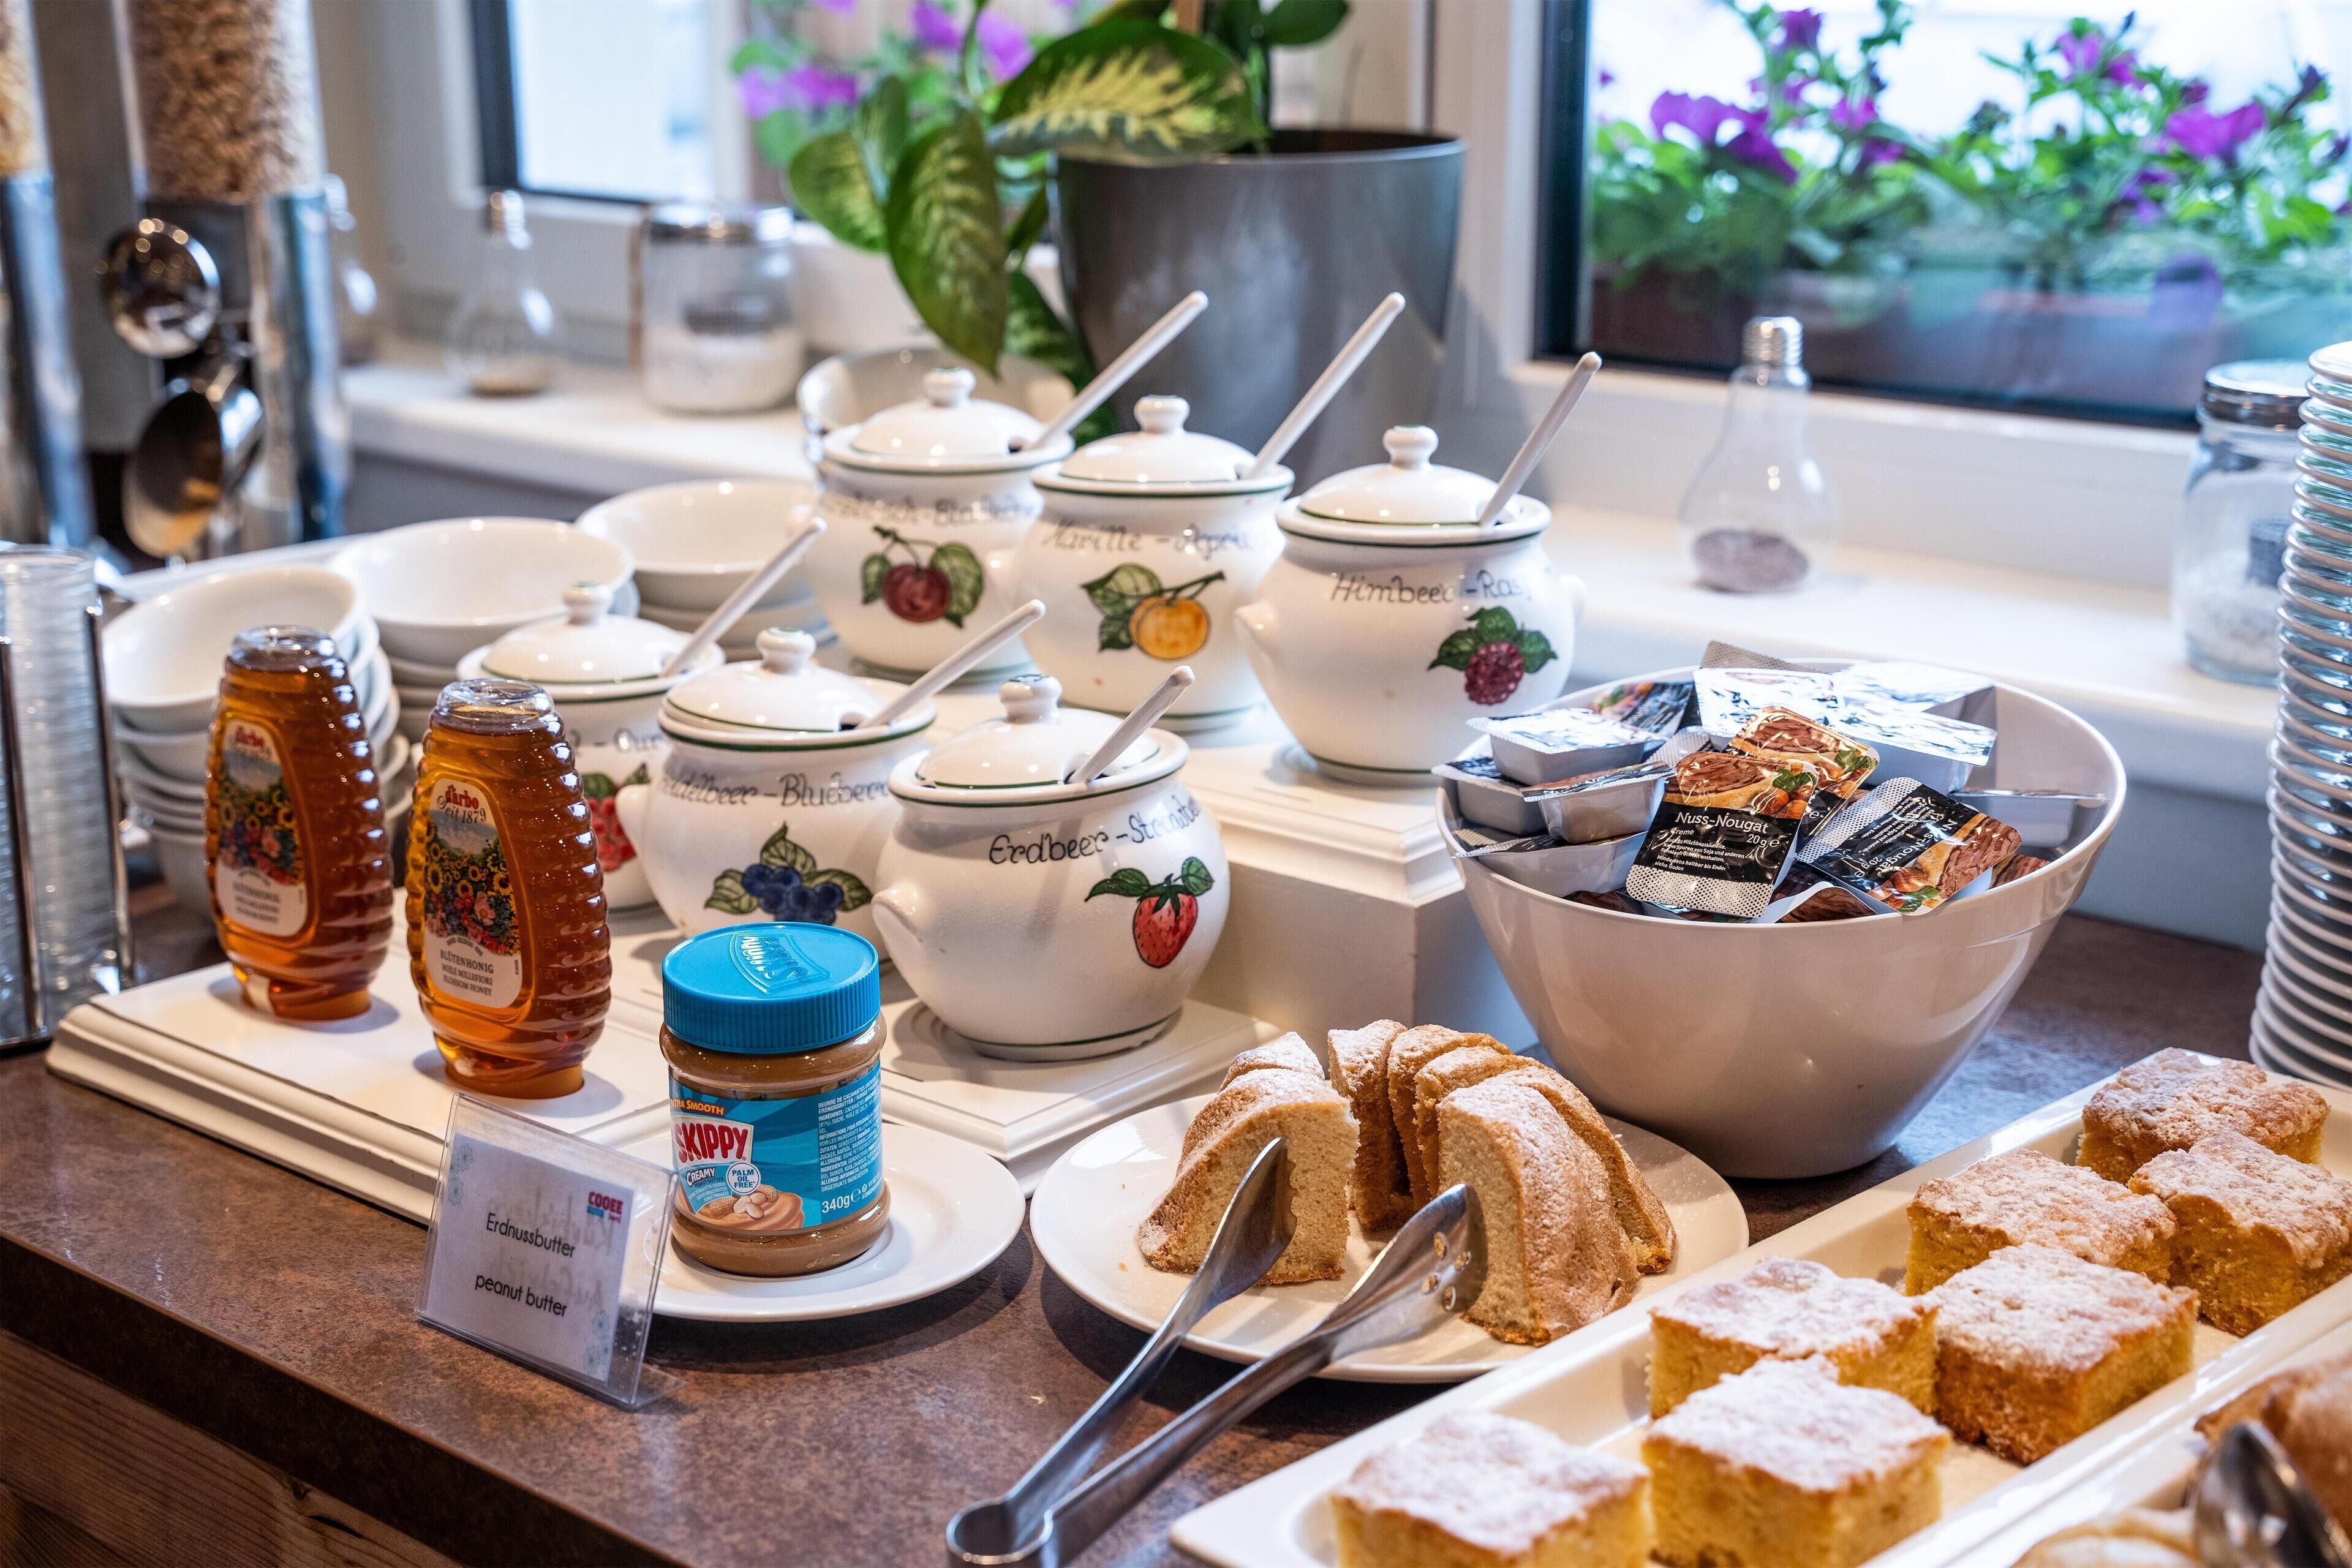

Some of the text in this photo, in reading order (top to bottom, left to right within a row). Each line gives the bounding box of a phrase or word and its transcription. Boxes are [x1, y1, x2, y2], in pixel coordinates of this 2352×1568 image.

[462, 808, 486, 824] 1879
[1675, 811, 1769, 834] Nuss-Nougat
[1657, 855, 1685, 865] Mindestens
[440, 949, 494, 974] BLÜTENHONIG
[458, 970, 492, 986] MILLEFIORI
[470, 983, 492, 996] HONEY
[686, 1100, 725, 1115] SMOOTH
[818, 1098, 836, 1109] BEURRE
[818, 1098, 853, 1114] ERDNUSSBUTTER
[819, 1127, 846, 1140] INFORMATIONS
[674, 1122, 748, 1163] SKIPPY
[820, 1144, 837, 1154] ZUTATEN:
[820, 1156, 842, 1166] ALLERGENE:
[687, 1167, 715, 1186] CREAMY
[588, 1191, 624, 1214] COOEE
[821, 1195, 850, 1213] 340g
[486, 1212, 576, 1258] Erdnussbutter
[475, 1274, 568, 1317] peanut butter
